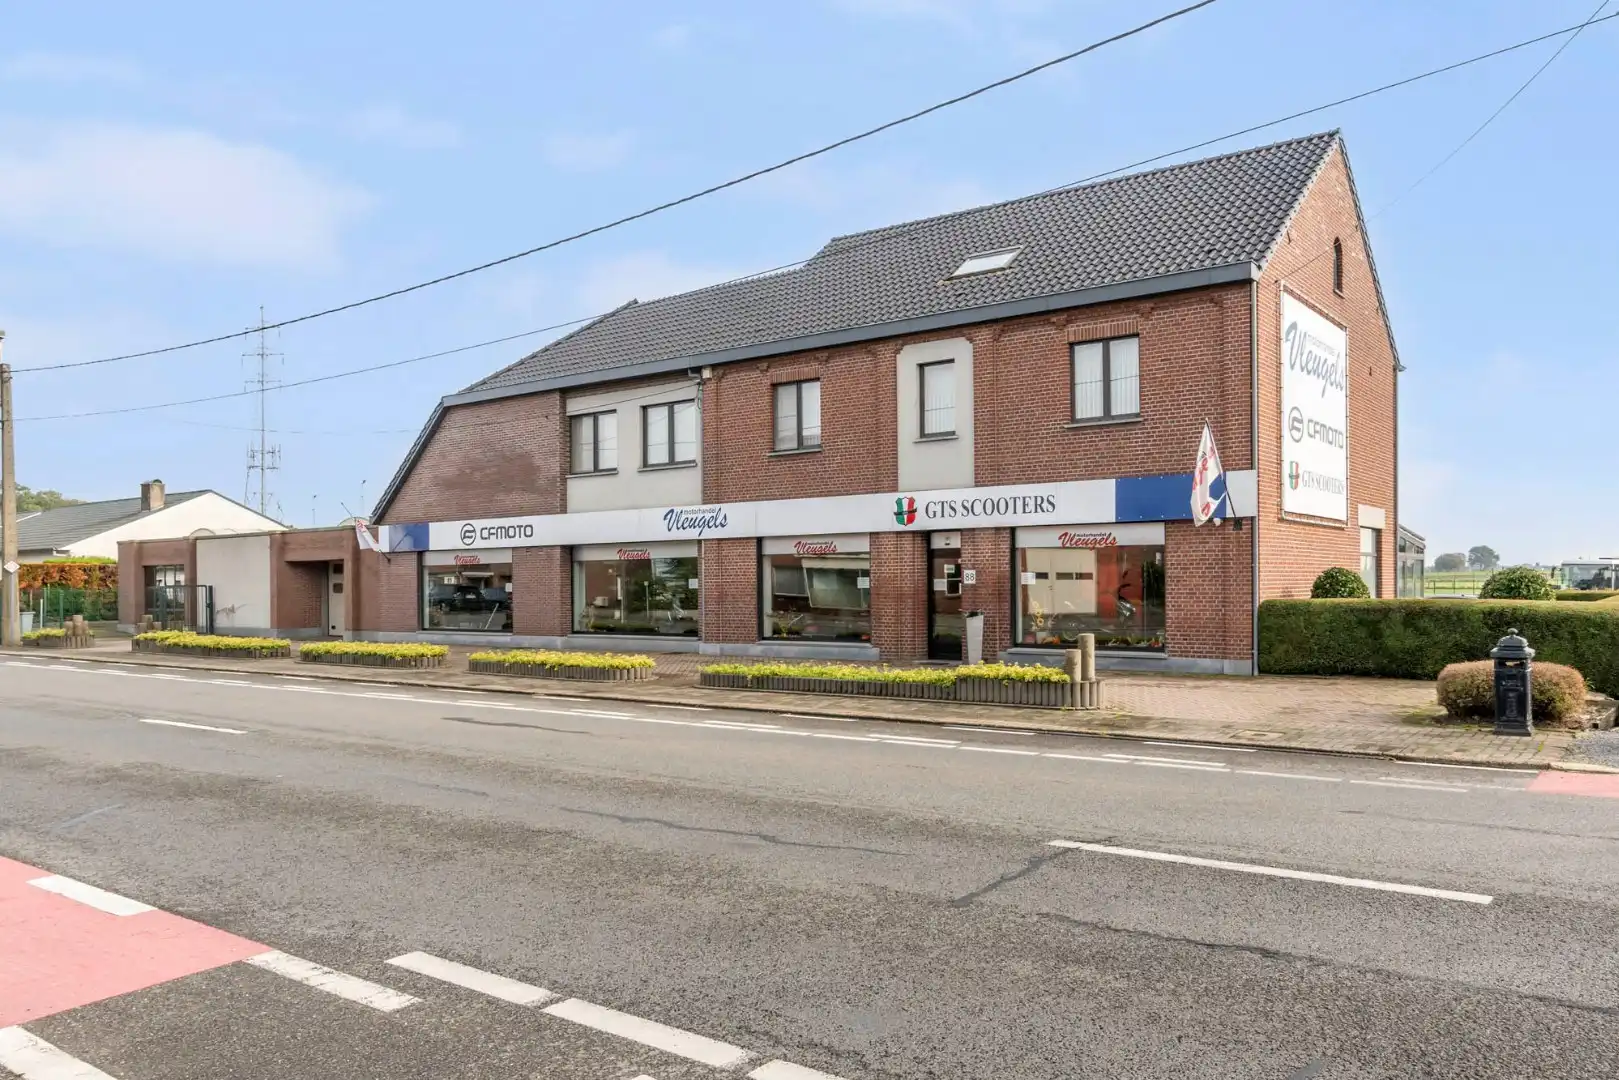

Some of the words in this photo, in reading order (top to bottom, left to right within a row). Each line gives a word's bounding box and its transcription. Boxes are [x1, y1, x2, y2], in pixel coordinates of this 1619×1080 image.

[1285, 321, 1344, 398] Vleugels
[1308, 419, 1344, 449] CFMOTO
[684, 507, 716, 515] motorhandel
[925, 500, 957, 519] GTS
[961, 494, 1056, 517] SCOOTERS
[480, 525, 534, 540] CFMOTO
[664, 506, 728, 537] Vleugels
[1058, 532, 1118, 551] Vleugels
[965, 573, 974, 582] 88
